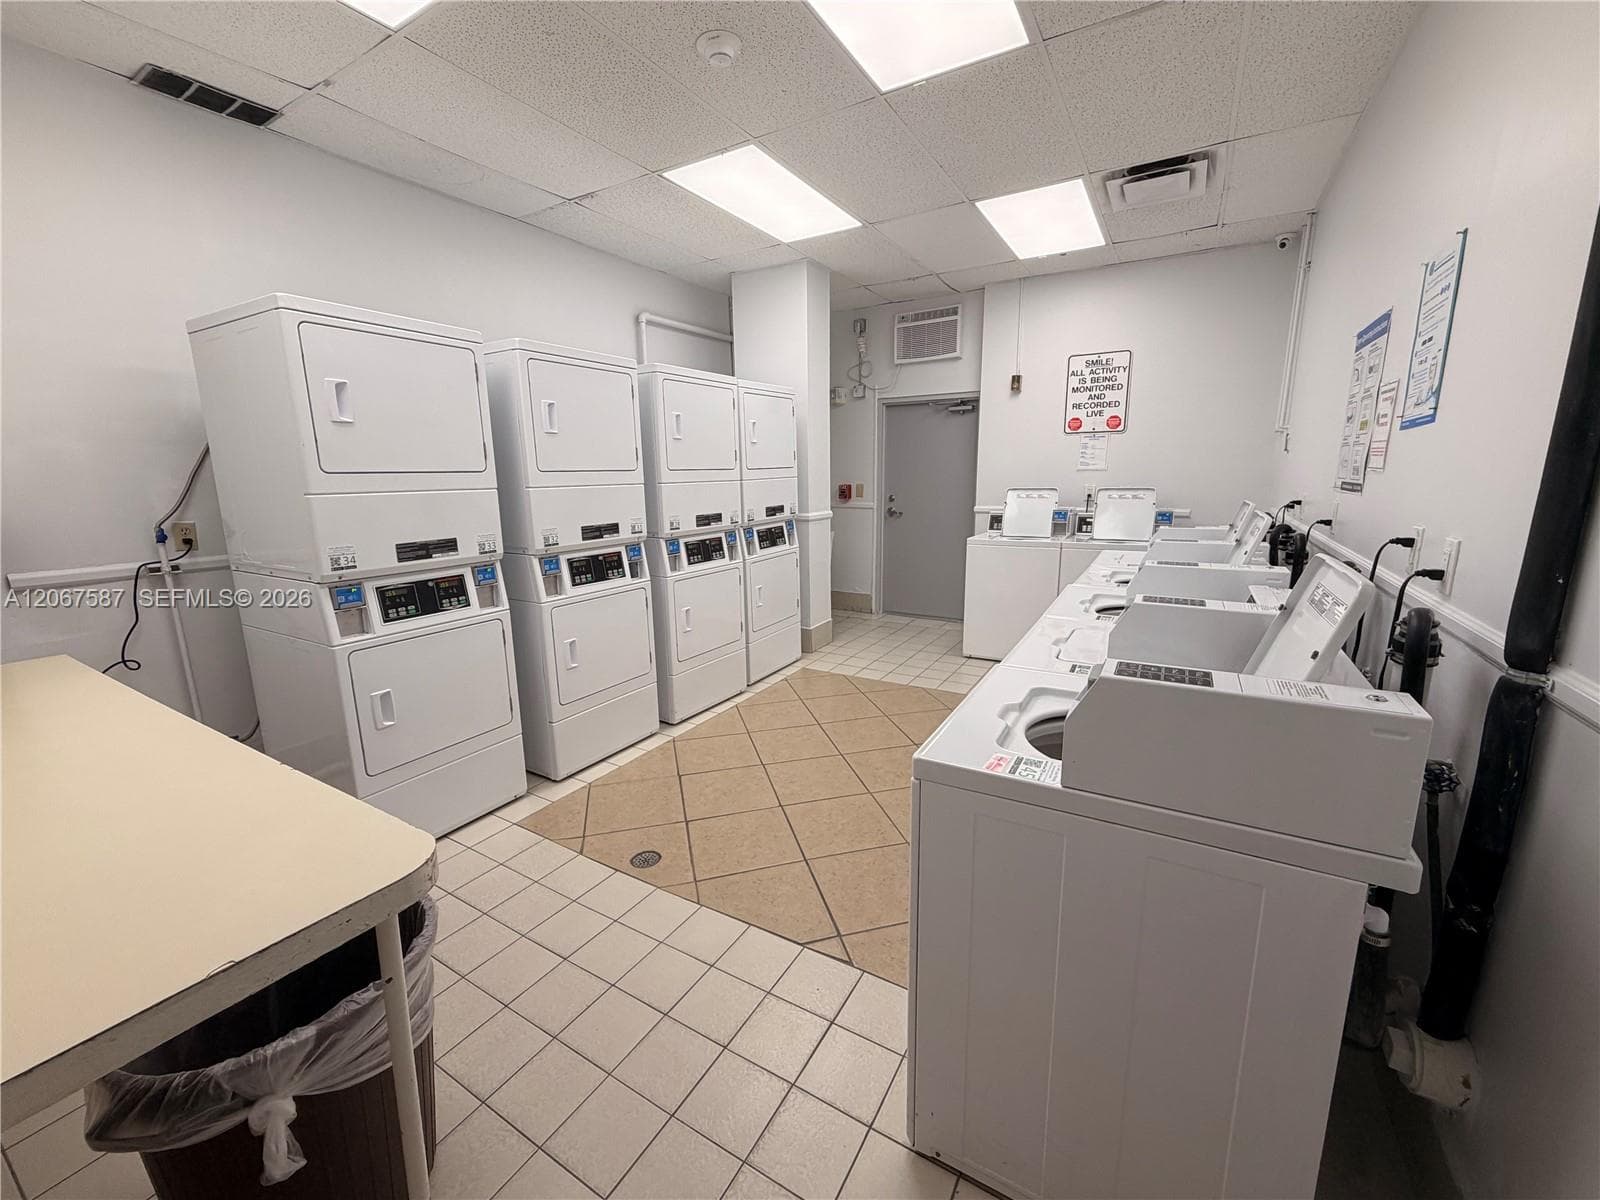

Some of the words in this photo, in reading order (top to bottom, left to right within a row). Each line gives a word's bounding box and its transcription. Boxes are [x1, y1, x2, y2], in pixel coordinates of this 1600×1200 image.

[1085, 358, 1114, 368] SMILE!
[1070, 369, 1085, 377] ALL
[1089, 366, 1128, 376] ACTIVITY
[1078, 377, 1087, 385] IS
[1090, 375, 1118, 384] BEING
[1071, 383, 1124, 393] MONITORED
[1087, 393, 1106, 401] AND
[1072, 401, 1120, 410] RECORDED
[1086, 410, 1105, 418] LIVE
[486, 541, 497, 550] 33
[342, 555, 356, 566] 34
[1018, 767, 1037, 779] 45
